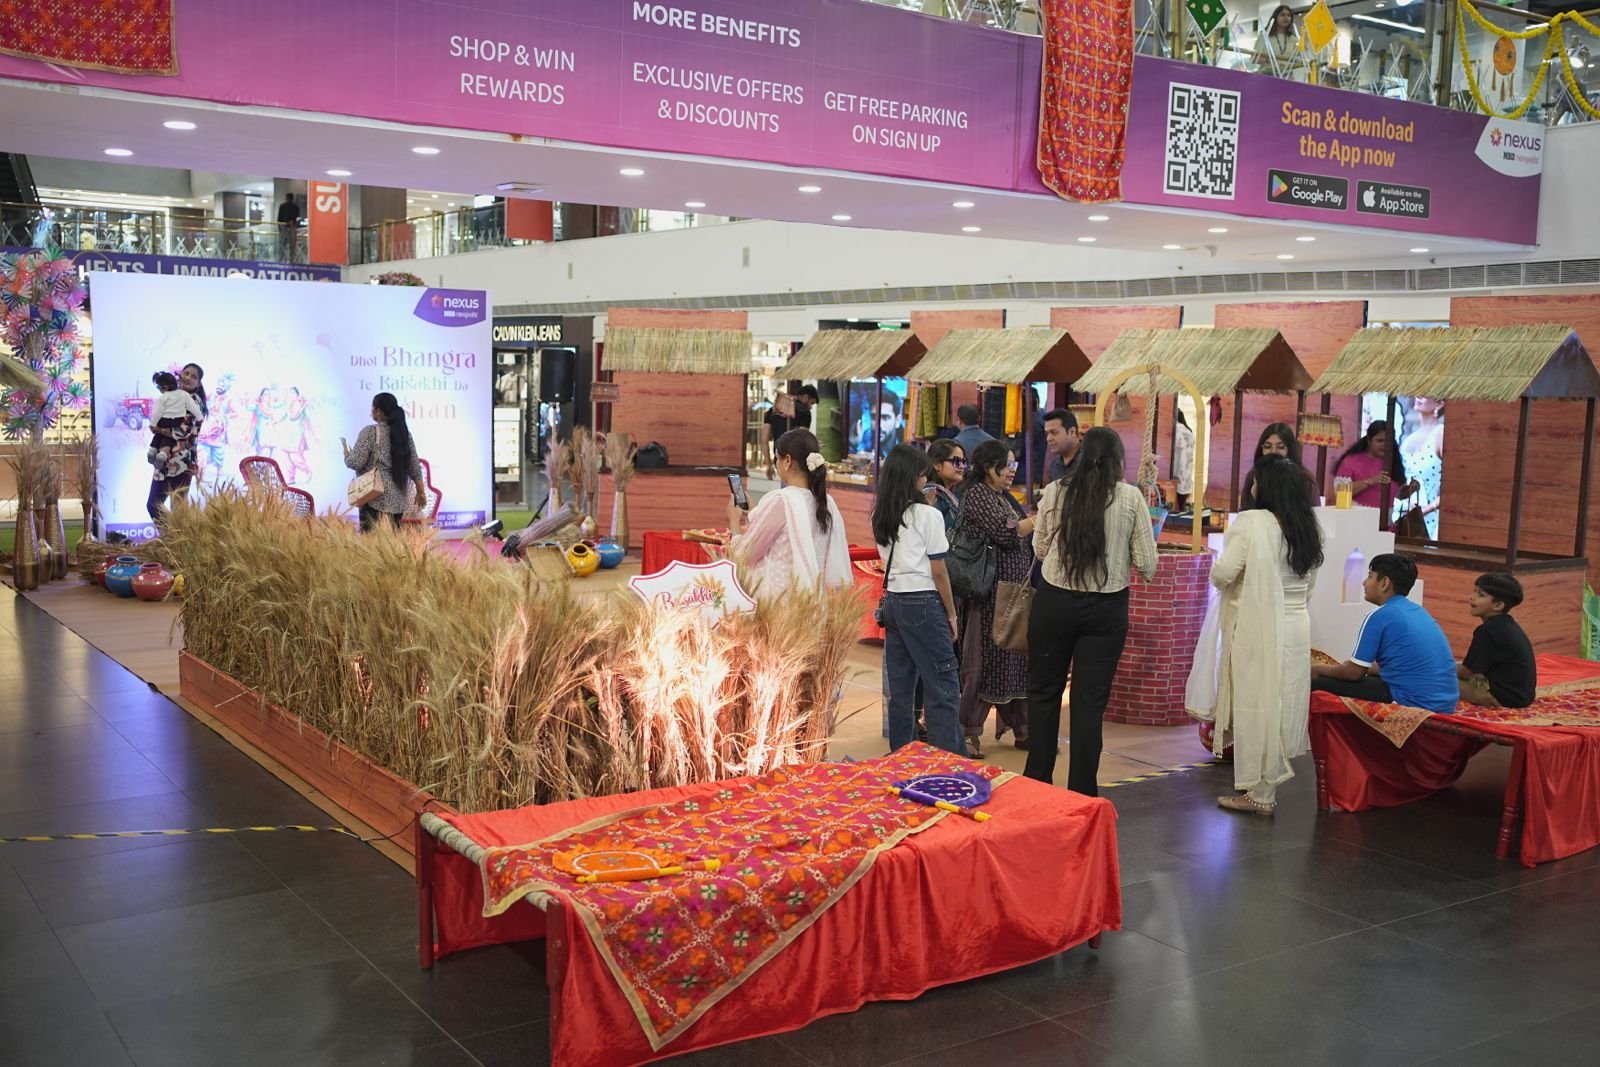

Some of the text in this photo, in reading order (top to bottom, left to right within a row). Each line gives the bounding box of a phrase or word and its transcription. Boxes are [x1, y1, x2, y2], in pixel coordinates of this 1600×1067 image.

[633, 1, 801, 48] MORE BENEFITS
[450, 35, 575, 72] SHOP & WIN
[460, 72, 565, 105] REWARDS
[633, 61, 804, 105] EXCLUSIVE OFFERS
[658, 99, 780, 133] & DISCOUNTS
[824, 91, 968, 129] GET FREE PARKING
[1281, 101, 1414, 143] Scan & download
[852, 125, 941, 152] ON SIGN UP
[1300, 134, 1395, 168] the App now
[1504, 132, 1541, 151] nexus
[1291, 186, 1343, 206] Google Play
[1380, 196, 1424, 213] App Store
[1381, 187, 1404, 197] Available
[443, 297, 479, 309] nexus
[493, 324, 561, 341] CALVIN KLEIN JEANS
[350, 346, 476, 375] Dhol Bhangra
[380, 375, 447, 391] Baisakhi
[454, 379, 468, 391] Da
